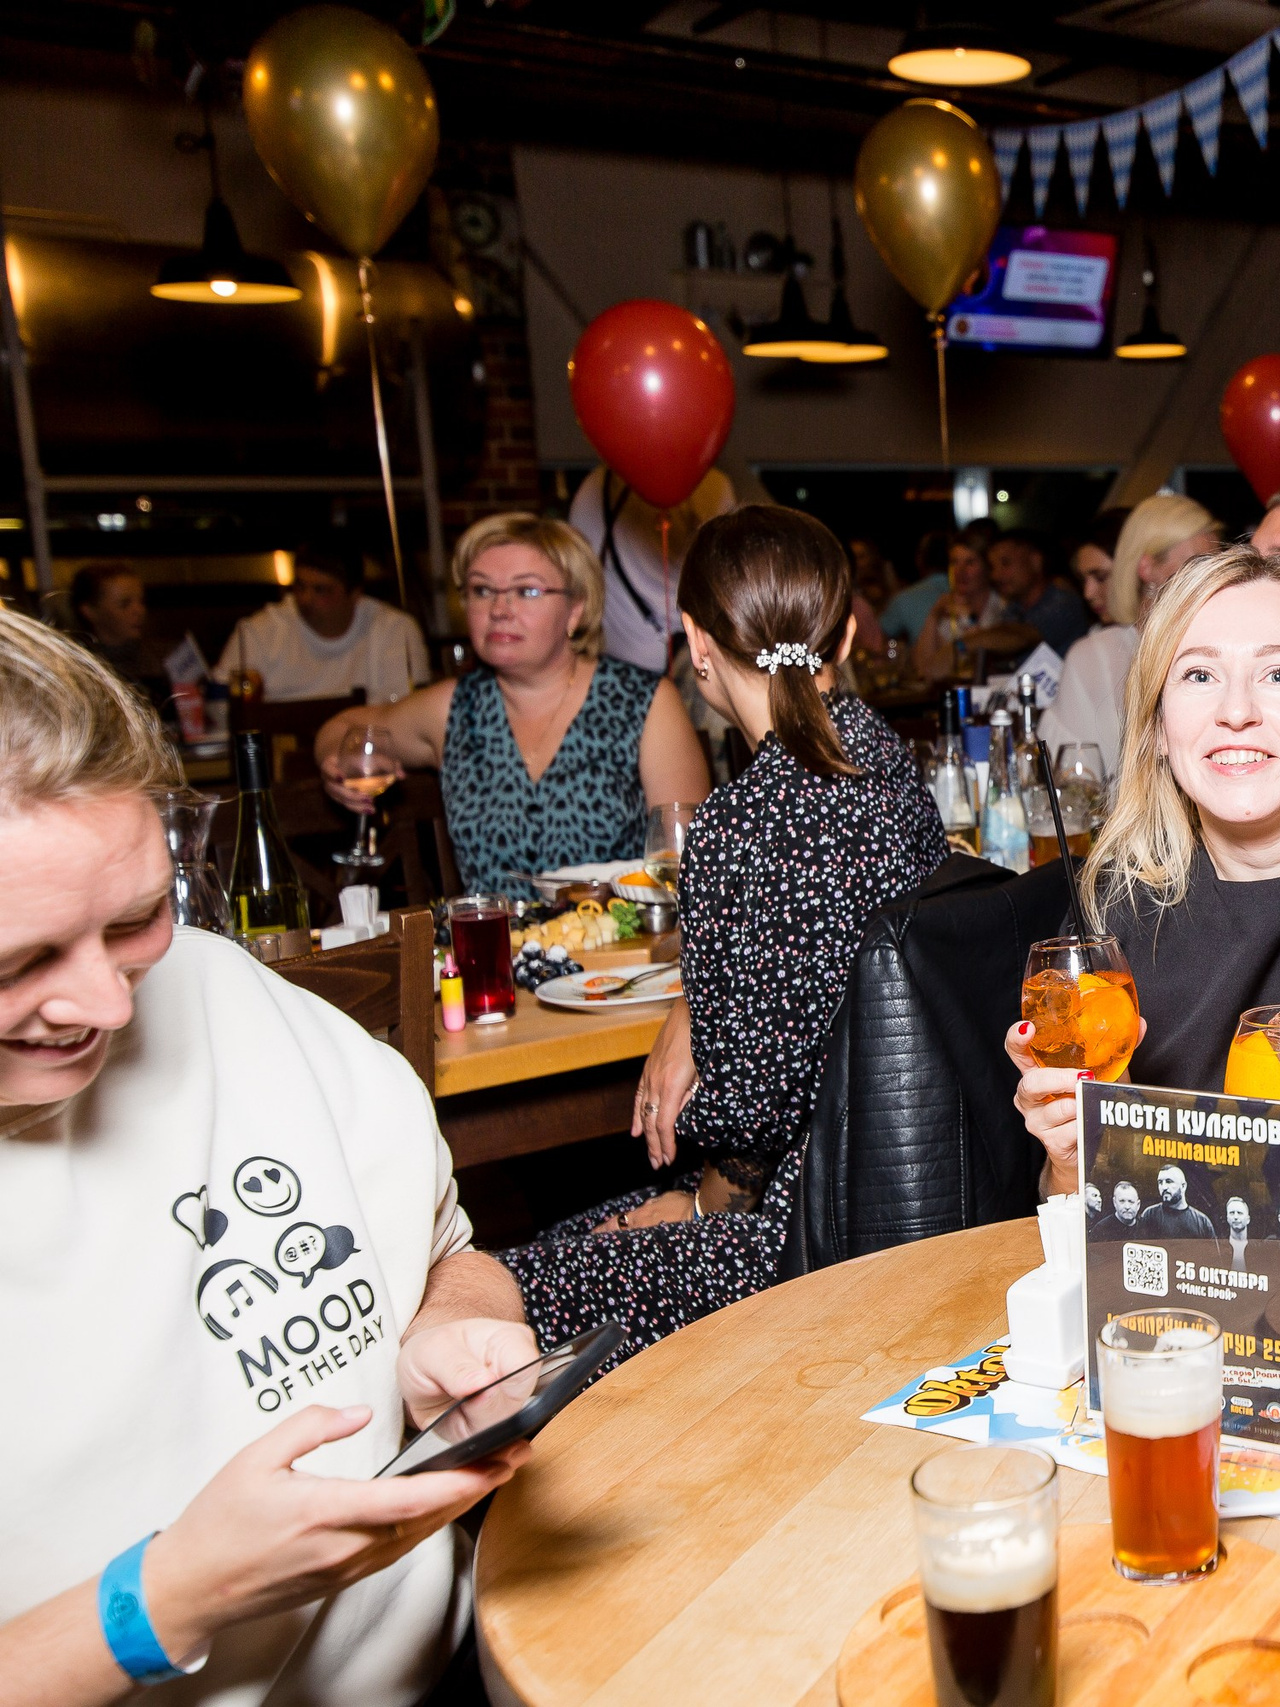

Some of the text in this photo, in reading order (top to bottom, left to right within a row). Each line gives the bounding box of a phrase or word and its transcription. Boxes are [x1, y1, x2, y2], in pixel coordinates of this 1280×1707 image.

[1100, 1100, 1170, 1132] КОСТЯ
[1175, 1260, 1269, 1292] 26 ОКТЯБРЯ
[236, 1278, 375, 1388] MOOD
[258, 1315, 385, 1412] OF THE DAY
